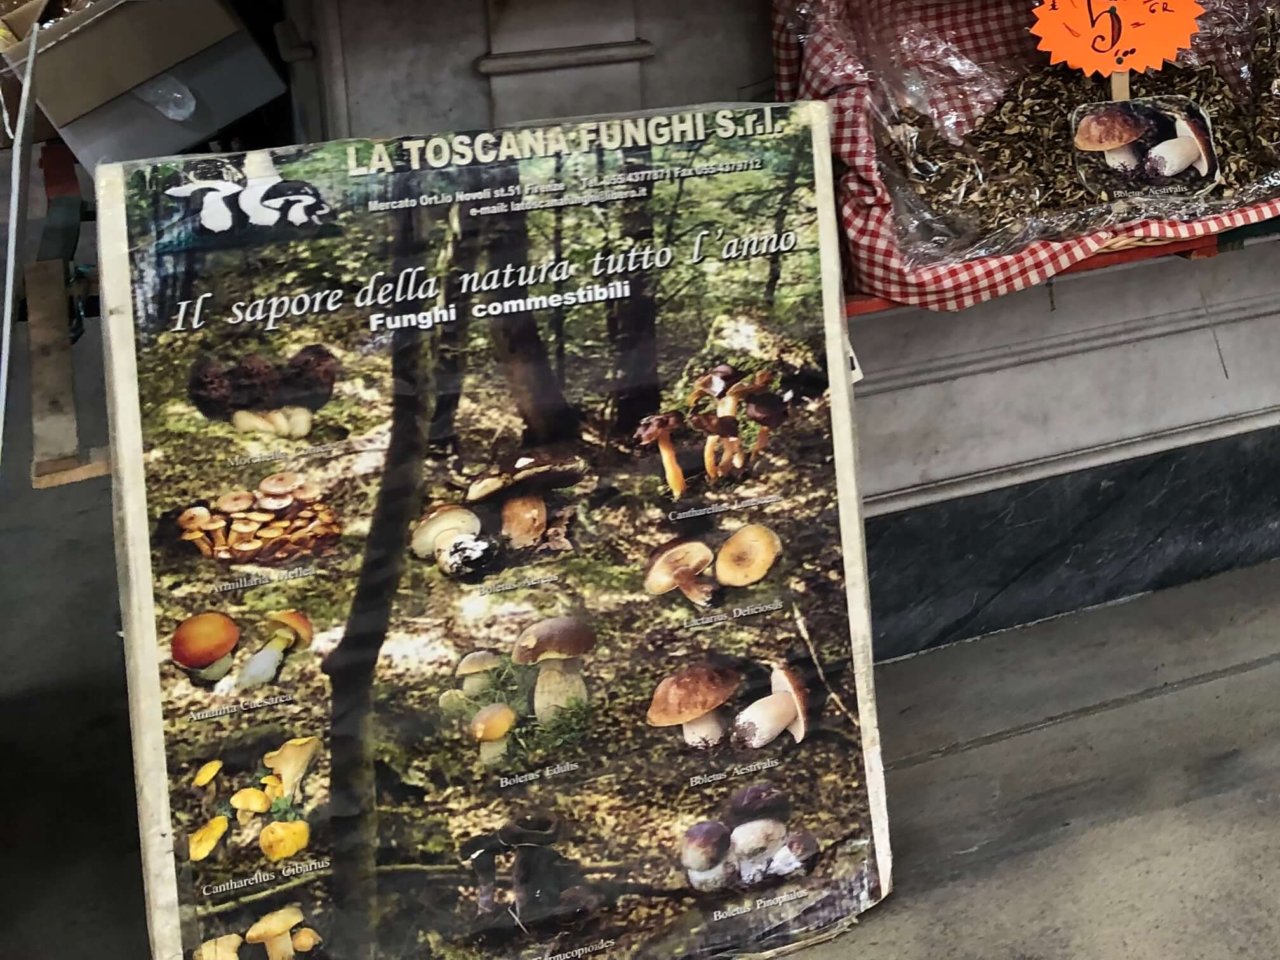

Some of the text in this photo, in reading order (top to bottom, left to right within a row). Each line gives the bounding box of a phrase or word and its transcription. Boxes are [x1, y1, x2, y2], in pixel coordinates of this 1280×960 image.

[1149, 1, 1175, 14] GR
[346, 106, 784, 177] LA TOSCANA FUNGHI S.r.l.
[368, 198, 418, 213] Mercato
[455, 189, 492, 204] Novoli
[493, 184, 522, 198] st.51
[524, 181, 566, 196] Firenze
[673, 165, 695, 179] Fax
[1113, 188, 1145, 199] Boletus
[469, 202, 509, 217] e-mail:
[170, 292, 213, 332] Il
[227, 288, 344, 332] sapore
[353, 265, 439, 309] della
[459, 258, 571, 295] natura
[590, 244, 672, 277] tutto
[369, 281, 631, 332] Funghi commestibili
[732, 598, 784, 620] Deliciosus
[499, 761, 580, 789] Boletus Edulis
[689, 757, 780, 788] Boletus Aestivalis
[202, 857, 331, 896] Cantharellus Cibarius
[713, 887, 809, 921] Boletus Pinophilus
